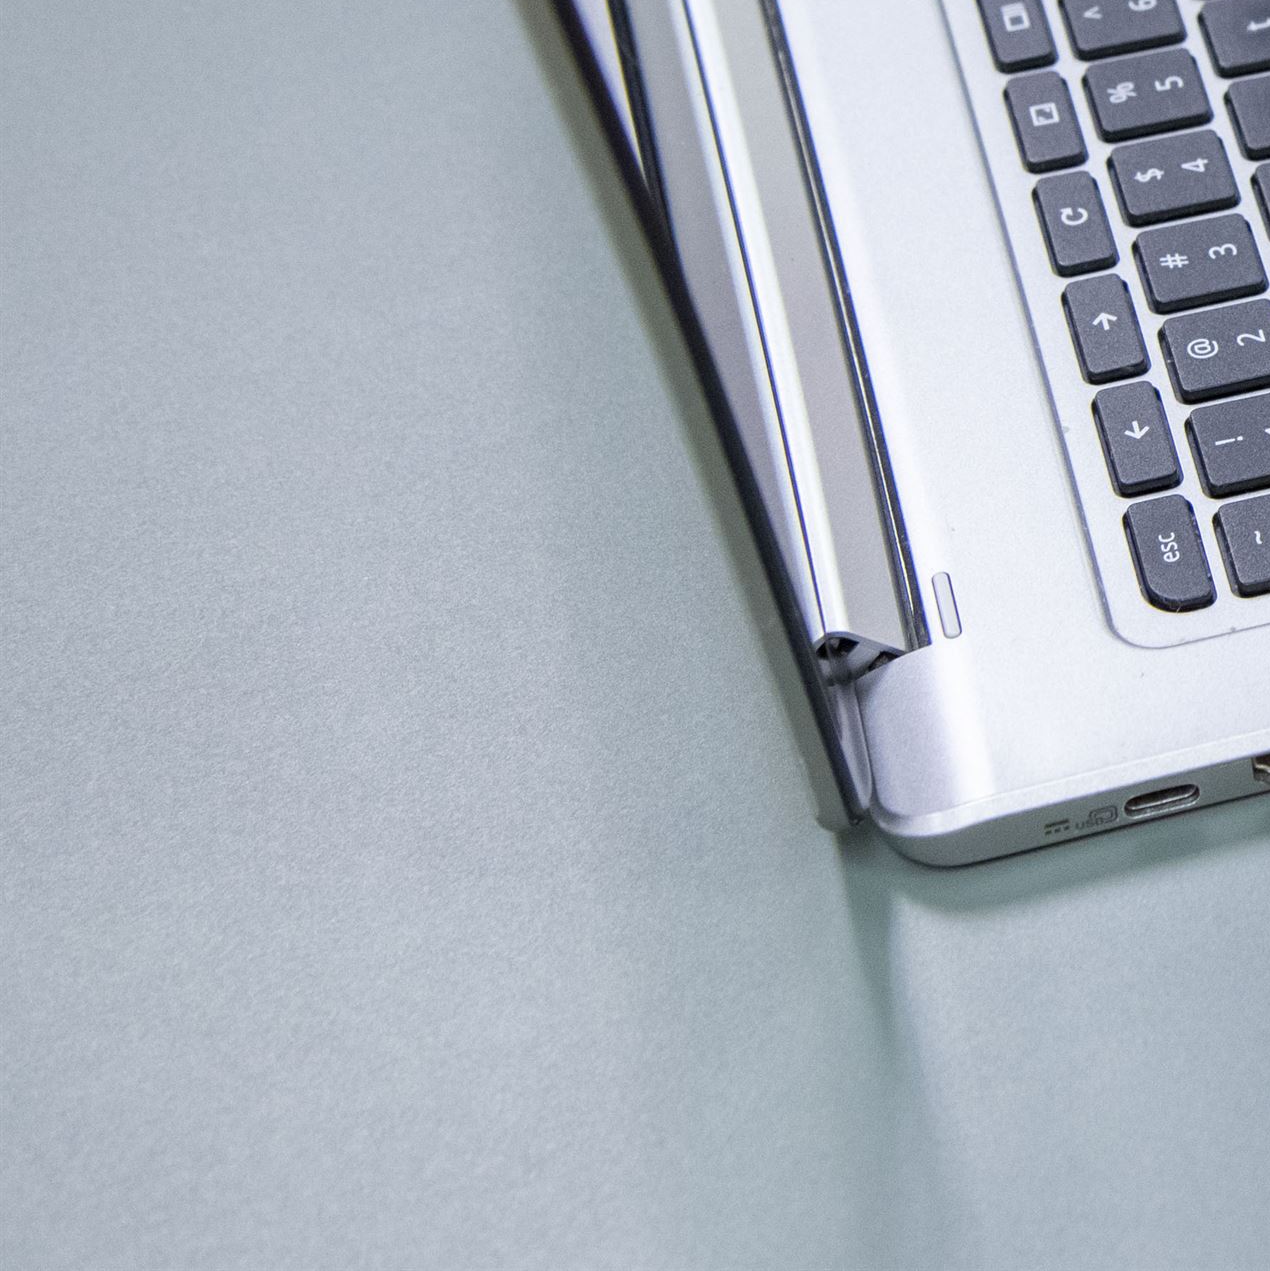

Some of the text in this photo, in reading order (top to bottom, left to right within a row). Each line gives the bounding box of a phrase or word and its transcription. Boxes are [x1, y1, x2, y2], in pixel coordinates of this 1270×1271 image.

[1155, 76, 1183, 91] 5
[1108, 82, 1136, 103] %
[1182, 158, 1207, 172] 4
[1135, 168, 1163, 182] $
[1209, 244, 1237, 259] 3
[1160, 254, 1188, 268] #
[1237, 330, 1265, 346] 2
[1187, 338, 1219, 359] @
[1214, 435, 1244, 446] !
[1158, 532, 1180, 562] esc
